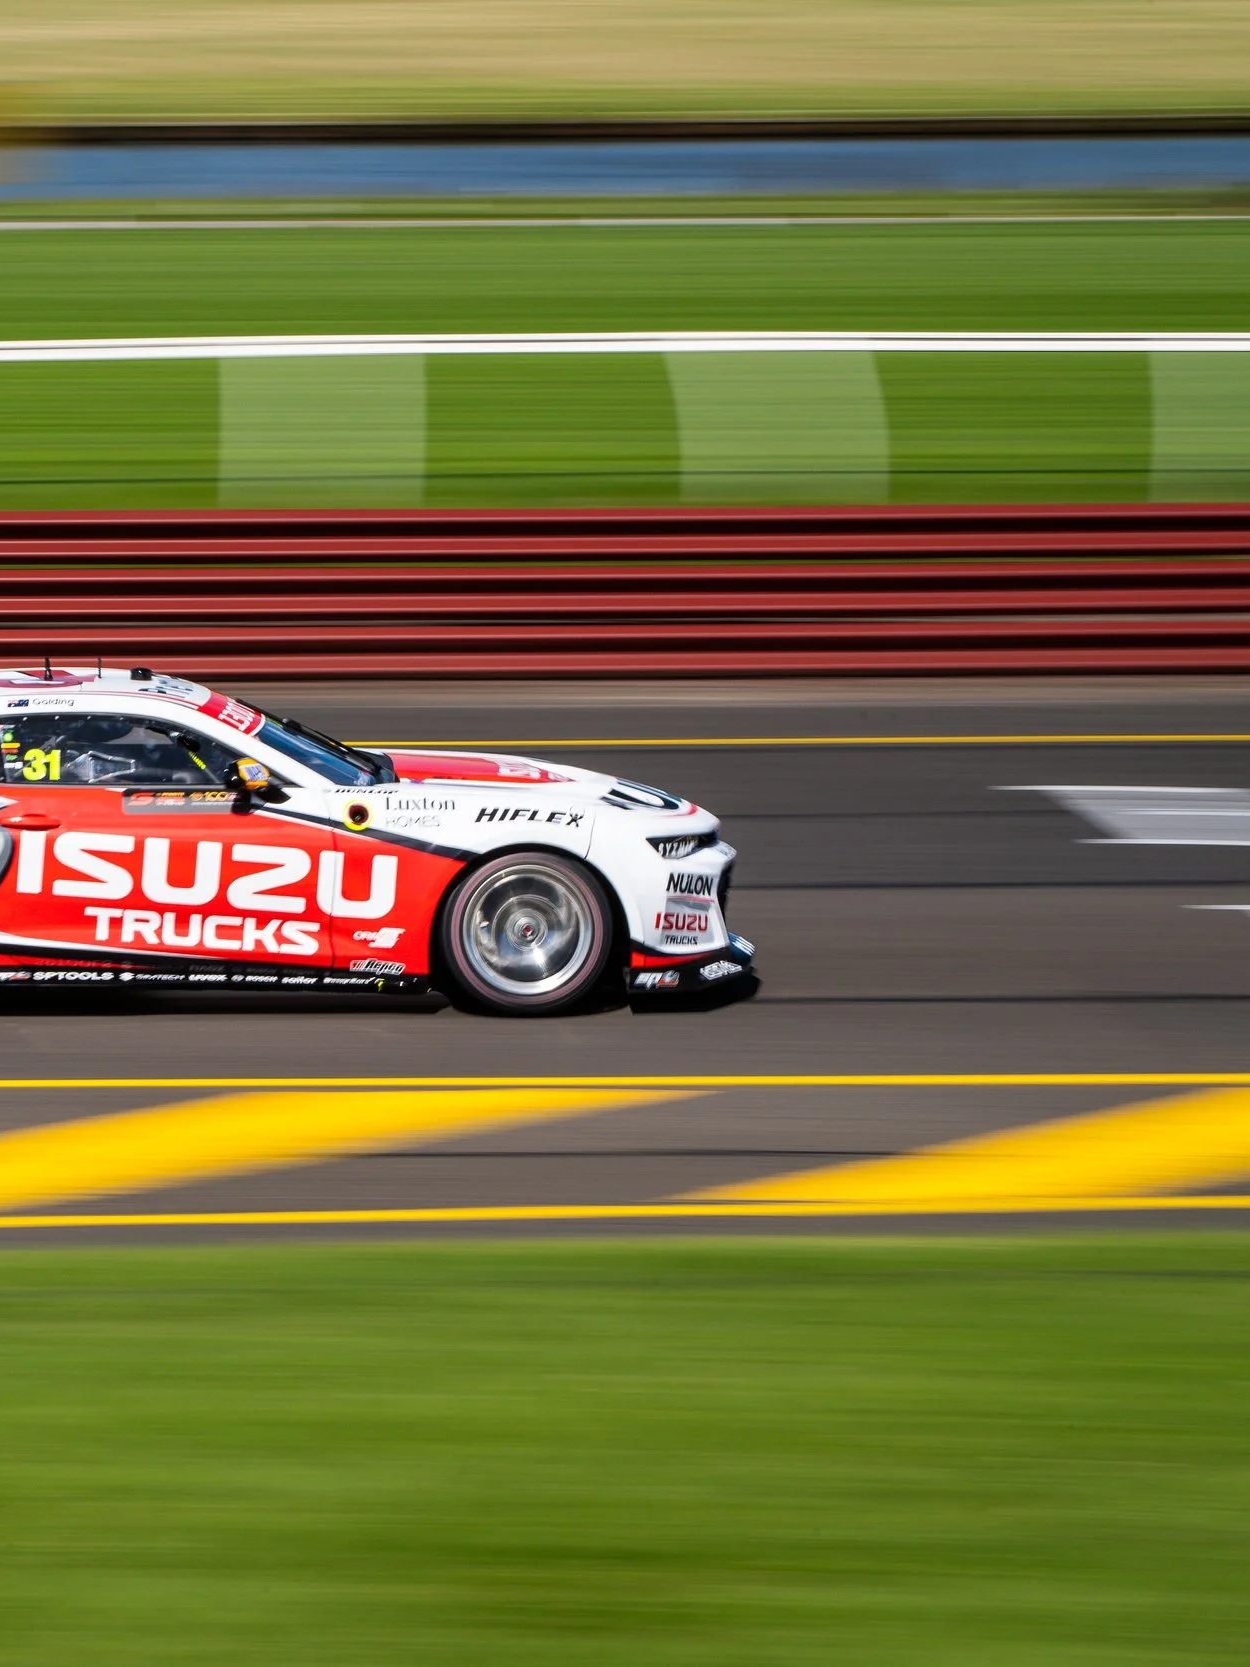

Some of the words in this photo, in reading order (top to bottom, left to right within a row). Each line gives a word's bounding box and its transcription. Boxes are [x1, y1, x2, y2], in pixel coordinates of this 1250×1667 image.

[32, 698, 75, 706] Golding
[22, 748, 62, 780] 31
[385, 797, 456, 811] Luxton
[385, 815, 441, 828] HOMES
[474, 805, 586, 828] HIFLEX
[15, 829, 398, 919] ISUZU
[666, 872, 713, 896] NULON
[84, 906, 321, 956] TRUCKS
[654, 911, 709, 932] ISUZU
[664, 934, 698, 945] TRUCKS
[364, 959, 403, 975] Repco
